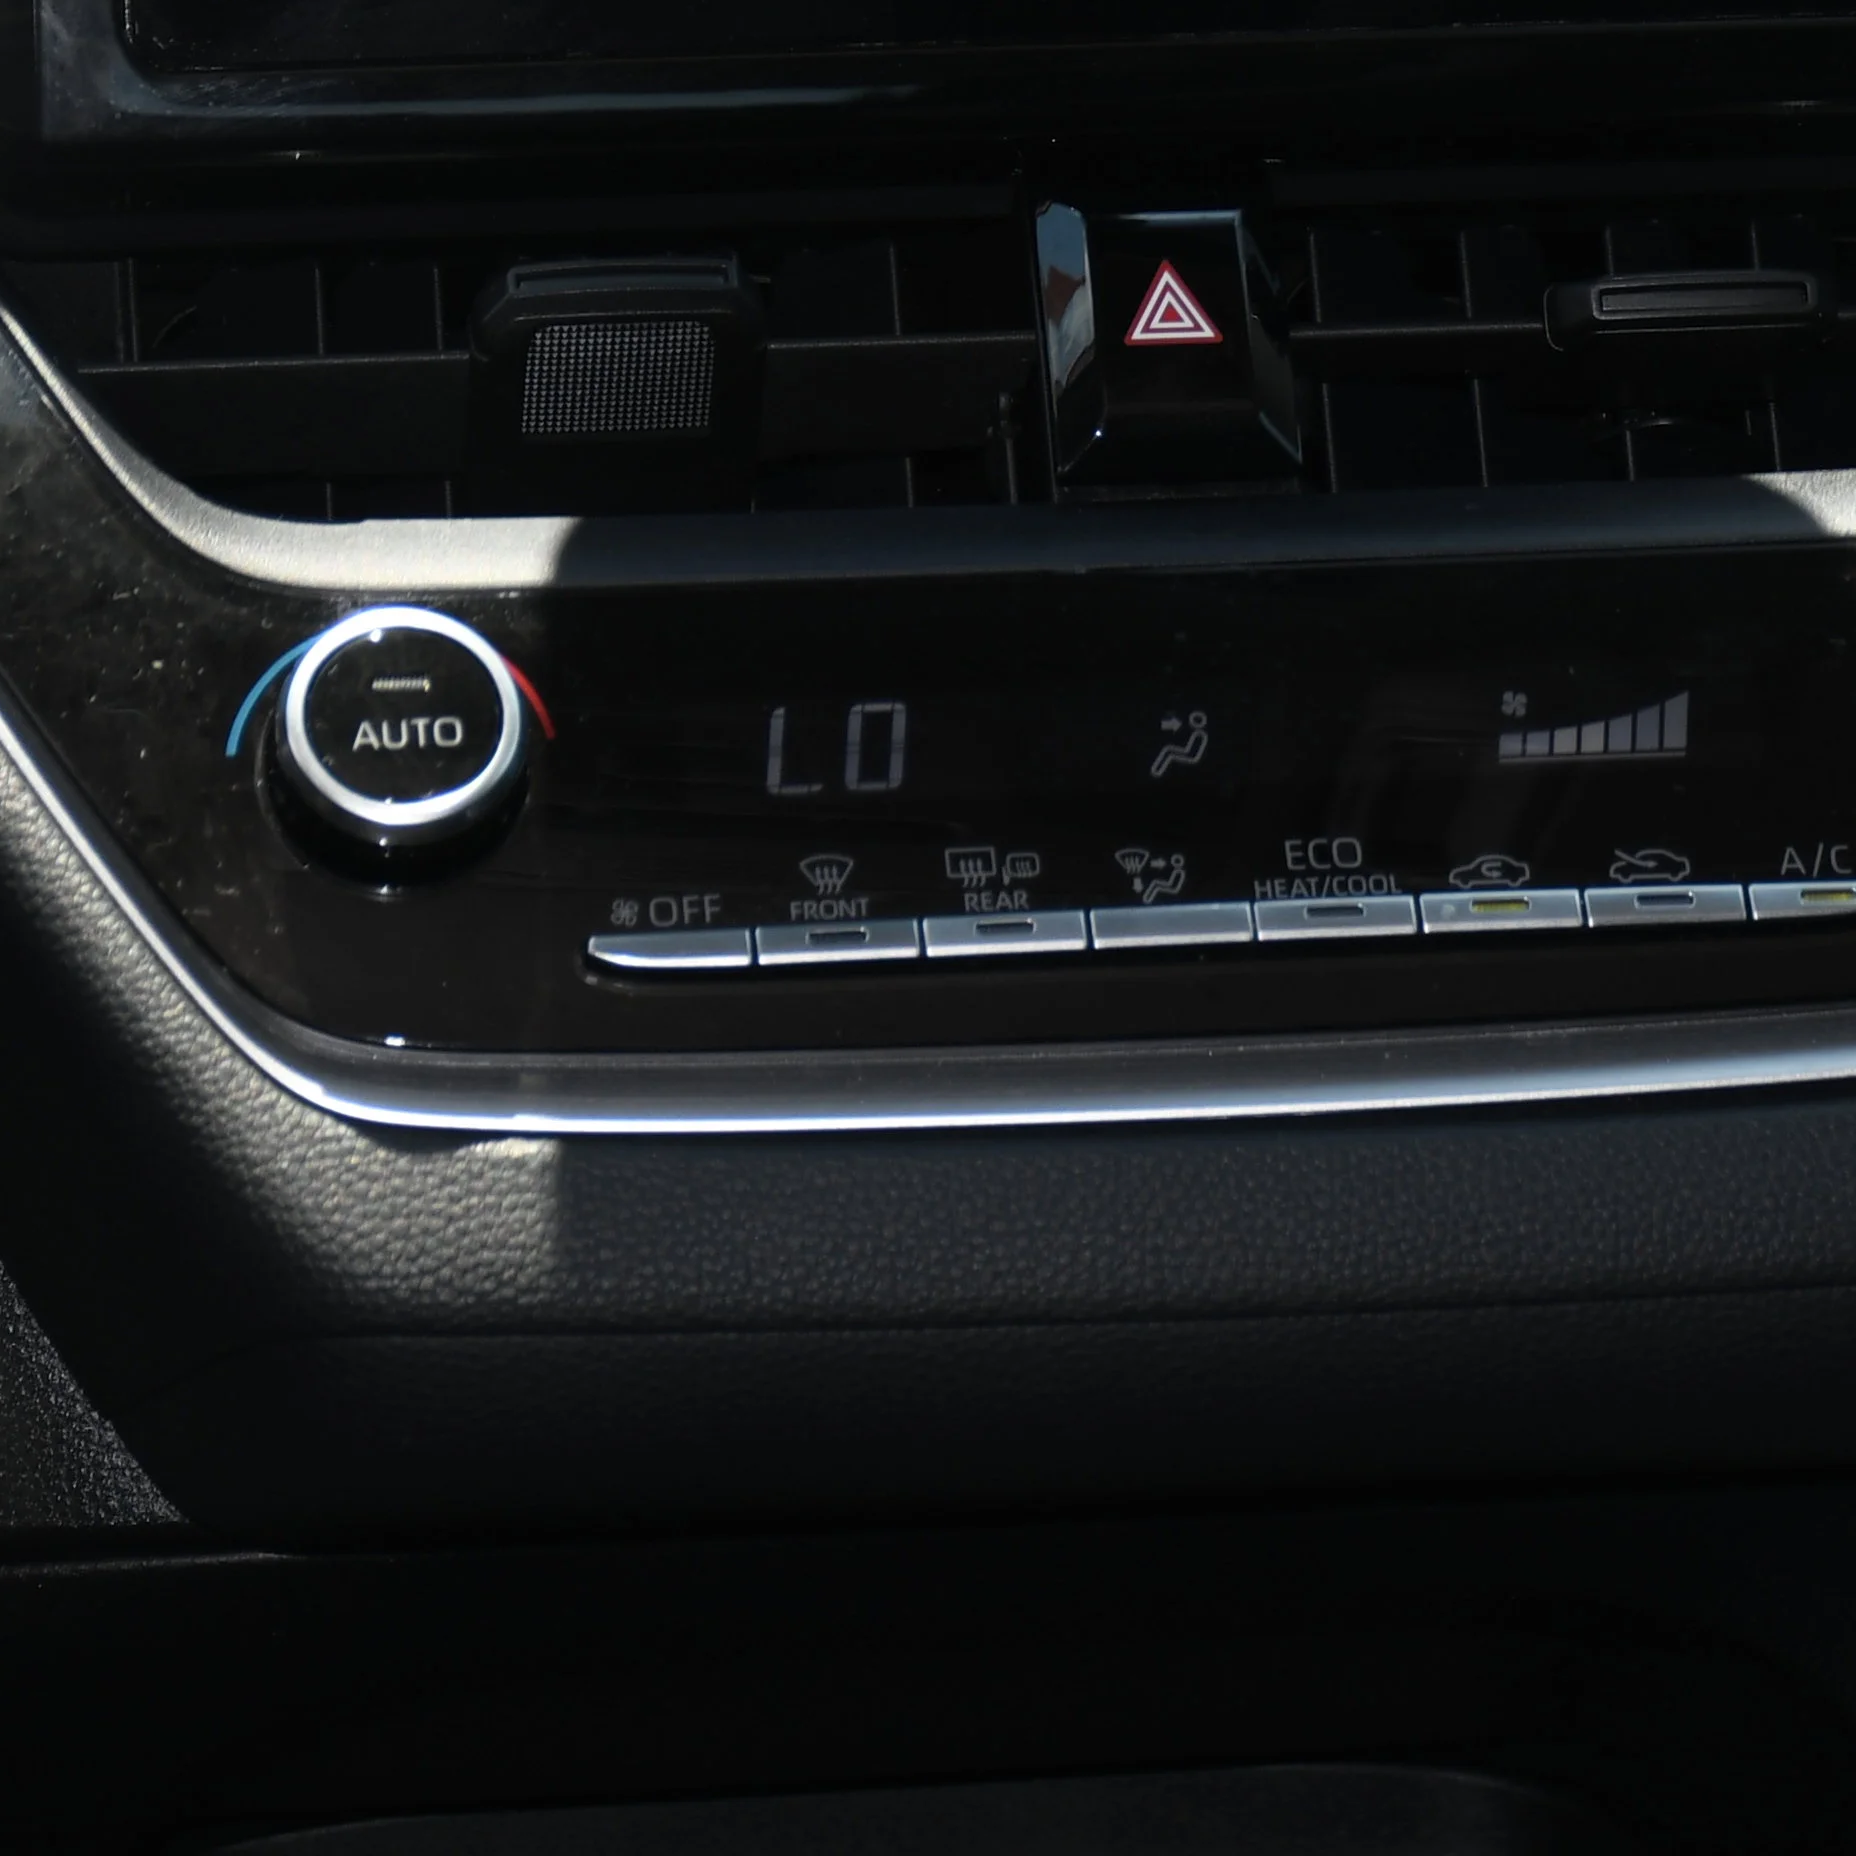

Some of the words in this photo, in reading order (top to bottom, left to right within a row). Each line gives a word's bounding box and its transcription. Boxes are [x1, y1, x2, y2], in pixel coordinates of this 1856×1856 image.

[352, 715, 464, 752] AUTO
[765, 701, 907, 795] LO
[1284, 838, 1363, 872] ECO
[1780, 843, 1853, 877] A/C
[963, 889, 1030, 913] REAR
[1253, 872, 1403, 901] HEAT/COOL
[648, 894, 723, 930] OFF
[789, 896, 870, 921] FRONT
